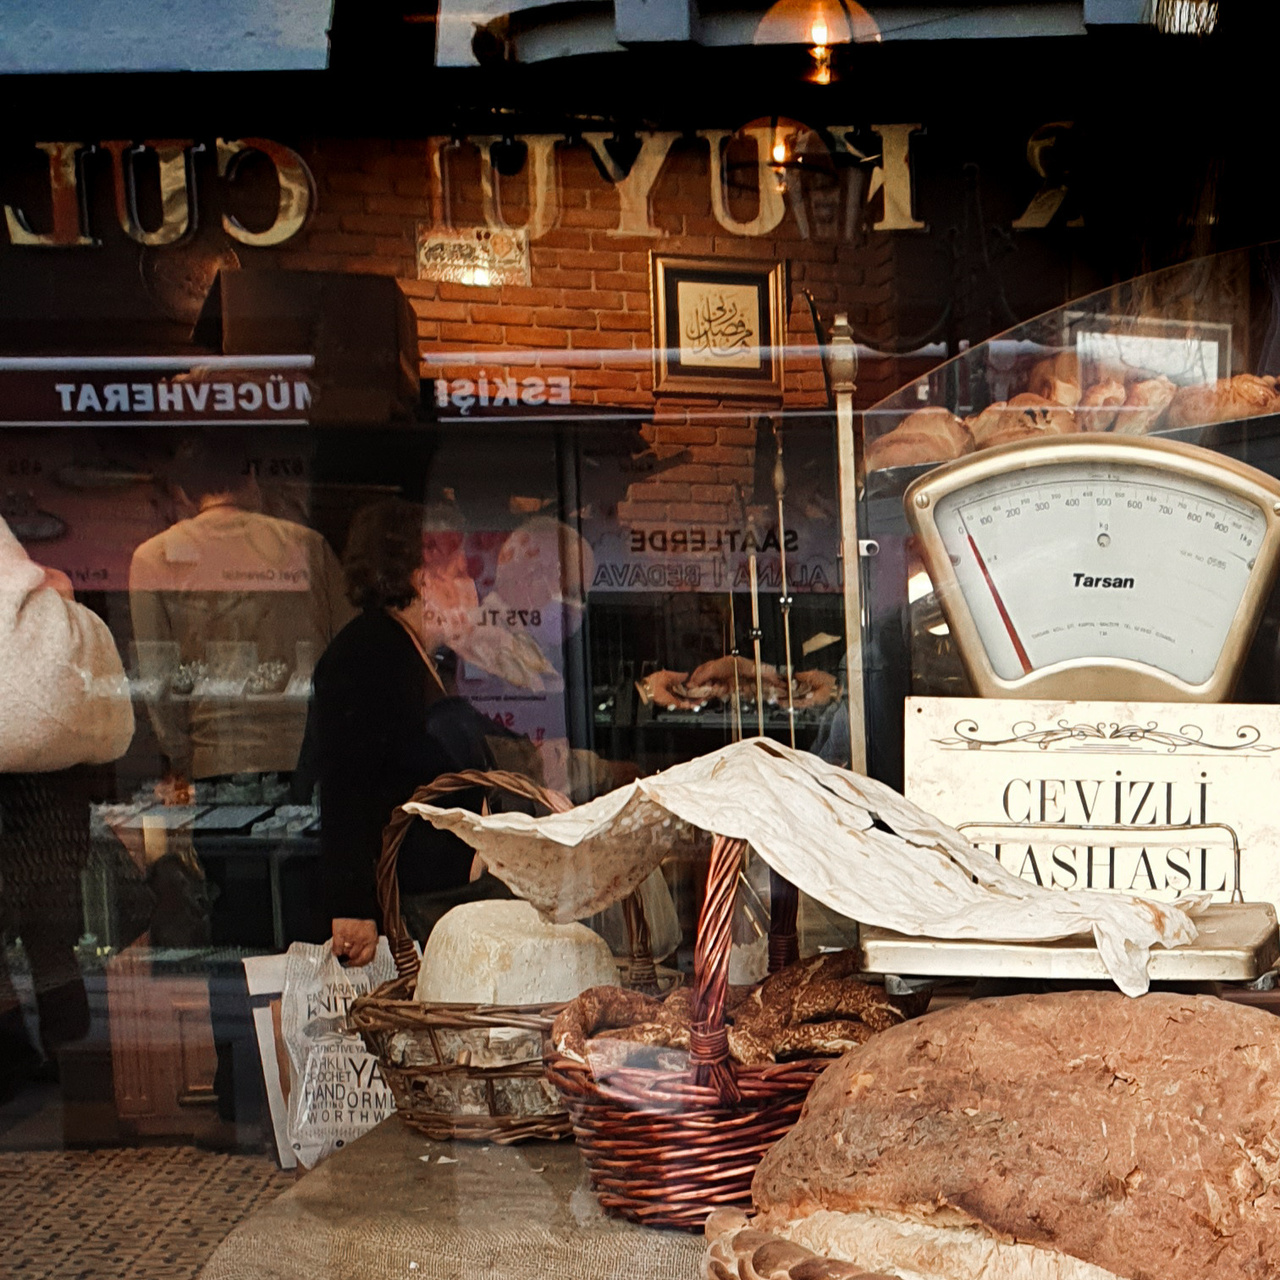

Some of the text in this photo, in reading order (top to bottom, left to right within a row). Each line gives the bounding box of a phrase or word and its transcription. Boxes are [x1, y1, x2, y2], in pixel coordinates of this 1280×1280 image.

[979, 515, 993, 526] 100
[1005, 507, 1021, 518] 200
[1034, 502, 1050, 512] 300
[1065, 498, 1080, 507] 400
[1095, 498, 1112, 507] 500
[1126, 500, 1143, 510] 600
[1158, 504, 1173, 515] 700
[1186, 511, 1203, 524] 800
[1213, 521, 1230, 534] 900
[1072, 572, 1135, 589] Tarsan
[1002, 769, 1214, 825] CEVİZLİ
[304, 1083, 346, 1103] HAND
